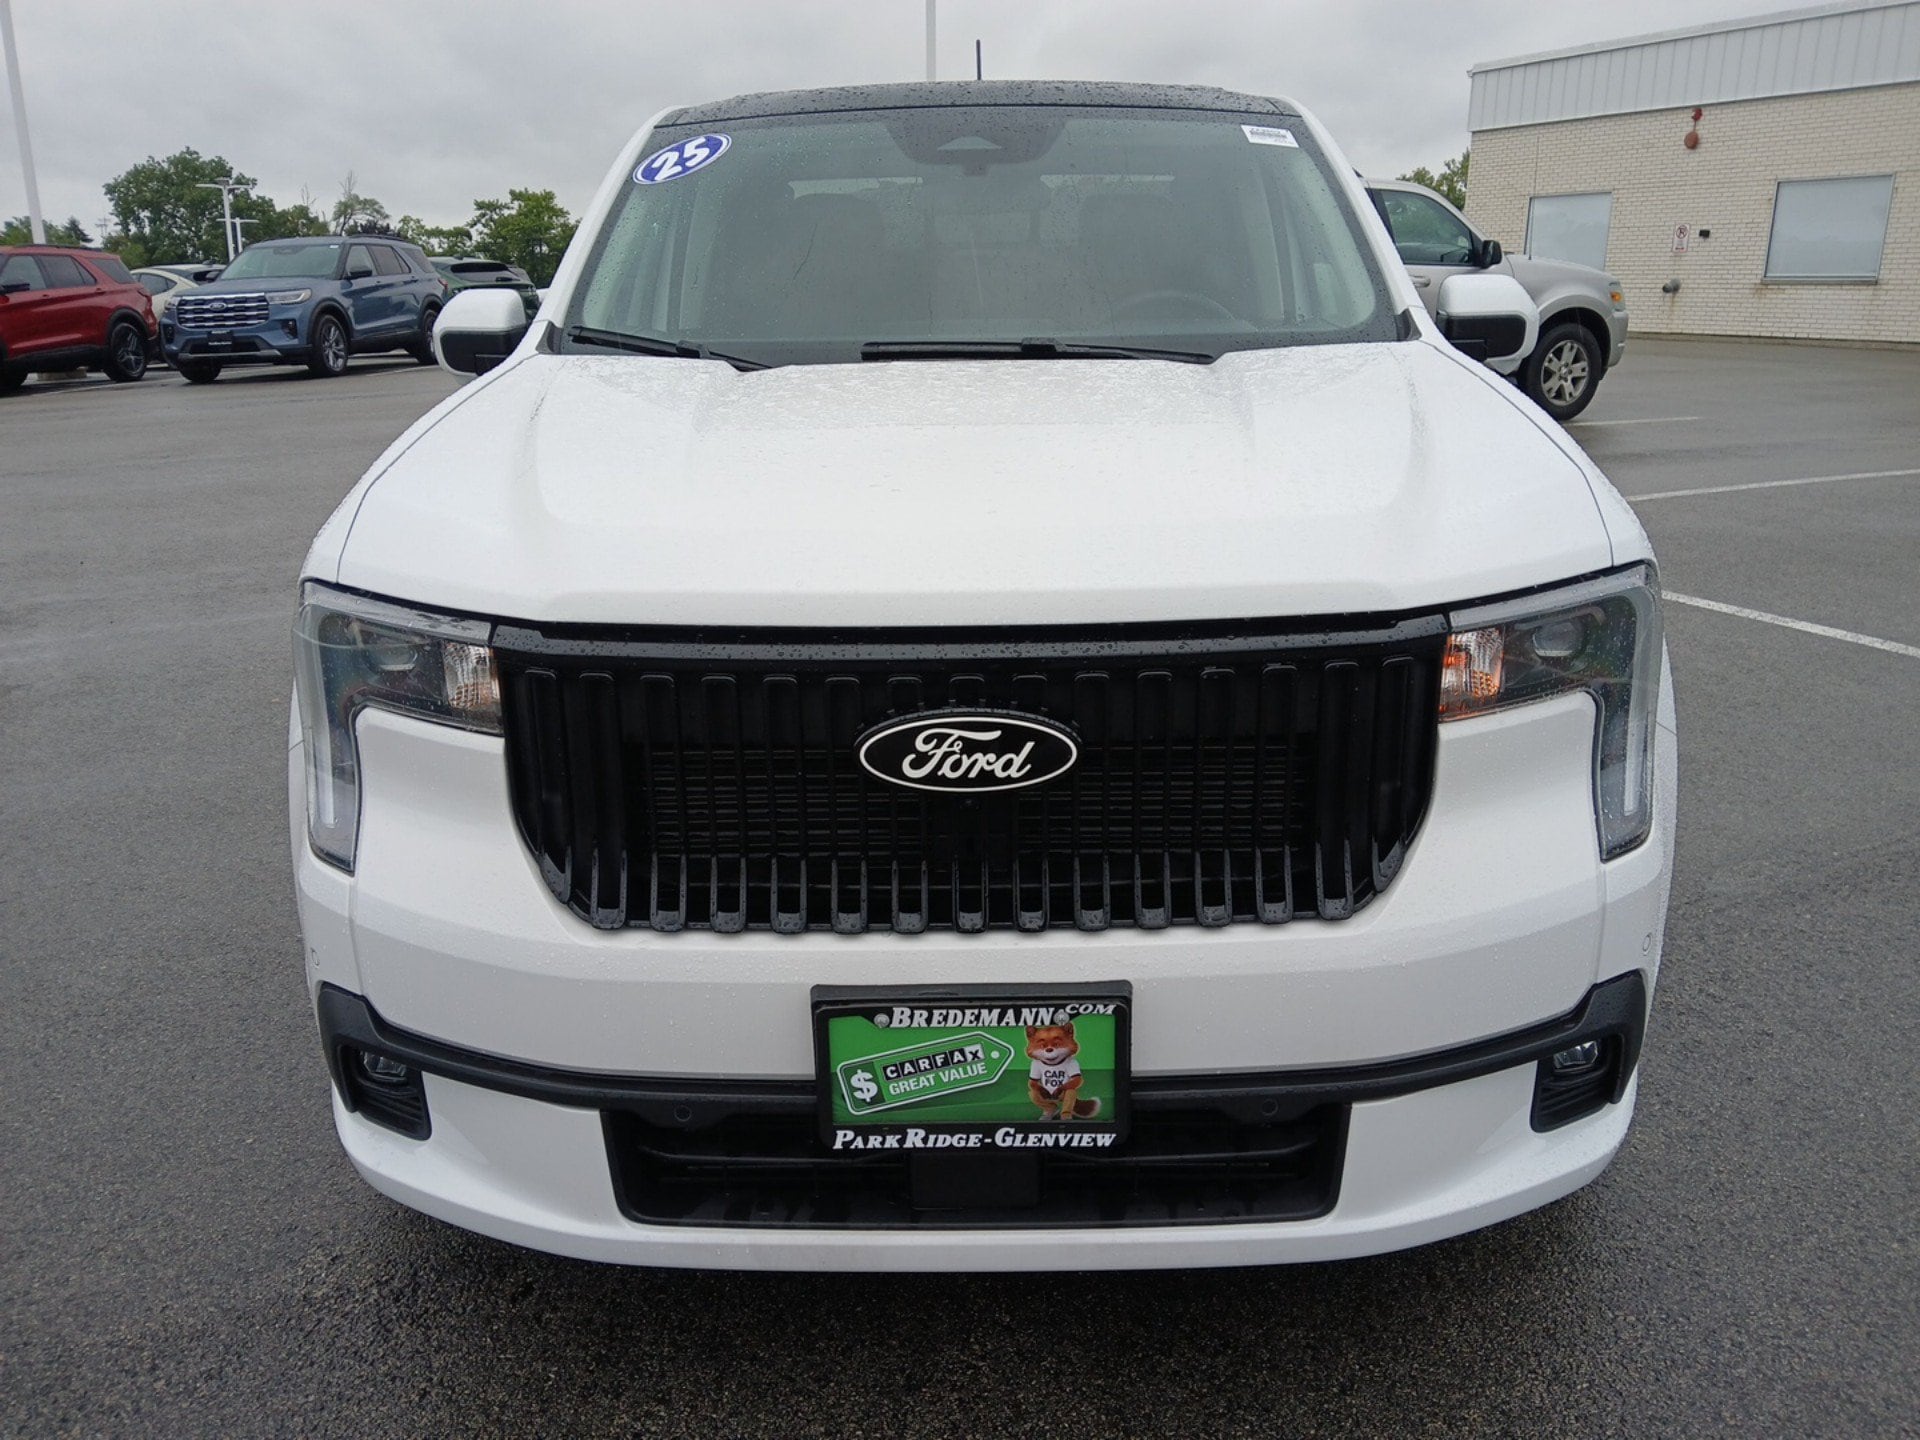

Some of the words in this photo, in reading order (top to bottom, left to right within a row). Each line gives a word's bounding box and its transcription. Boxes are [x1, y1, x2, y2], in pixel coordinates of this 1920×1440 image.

[651, 136, 710, 181] 25
[902, 727, 1035, 779] Ford
[885, 1046, 981, 1078] CARFAX
[1044, 1070, 1065, 1079] CAR
[888, 1074, 936, 1096] GREAT
[940, 1062, 988, 1083] VALUE
[1045, 1078, 1064, 1087] FOX
